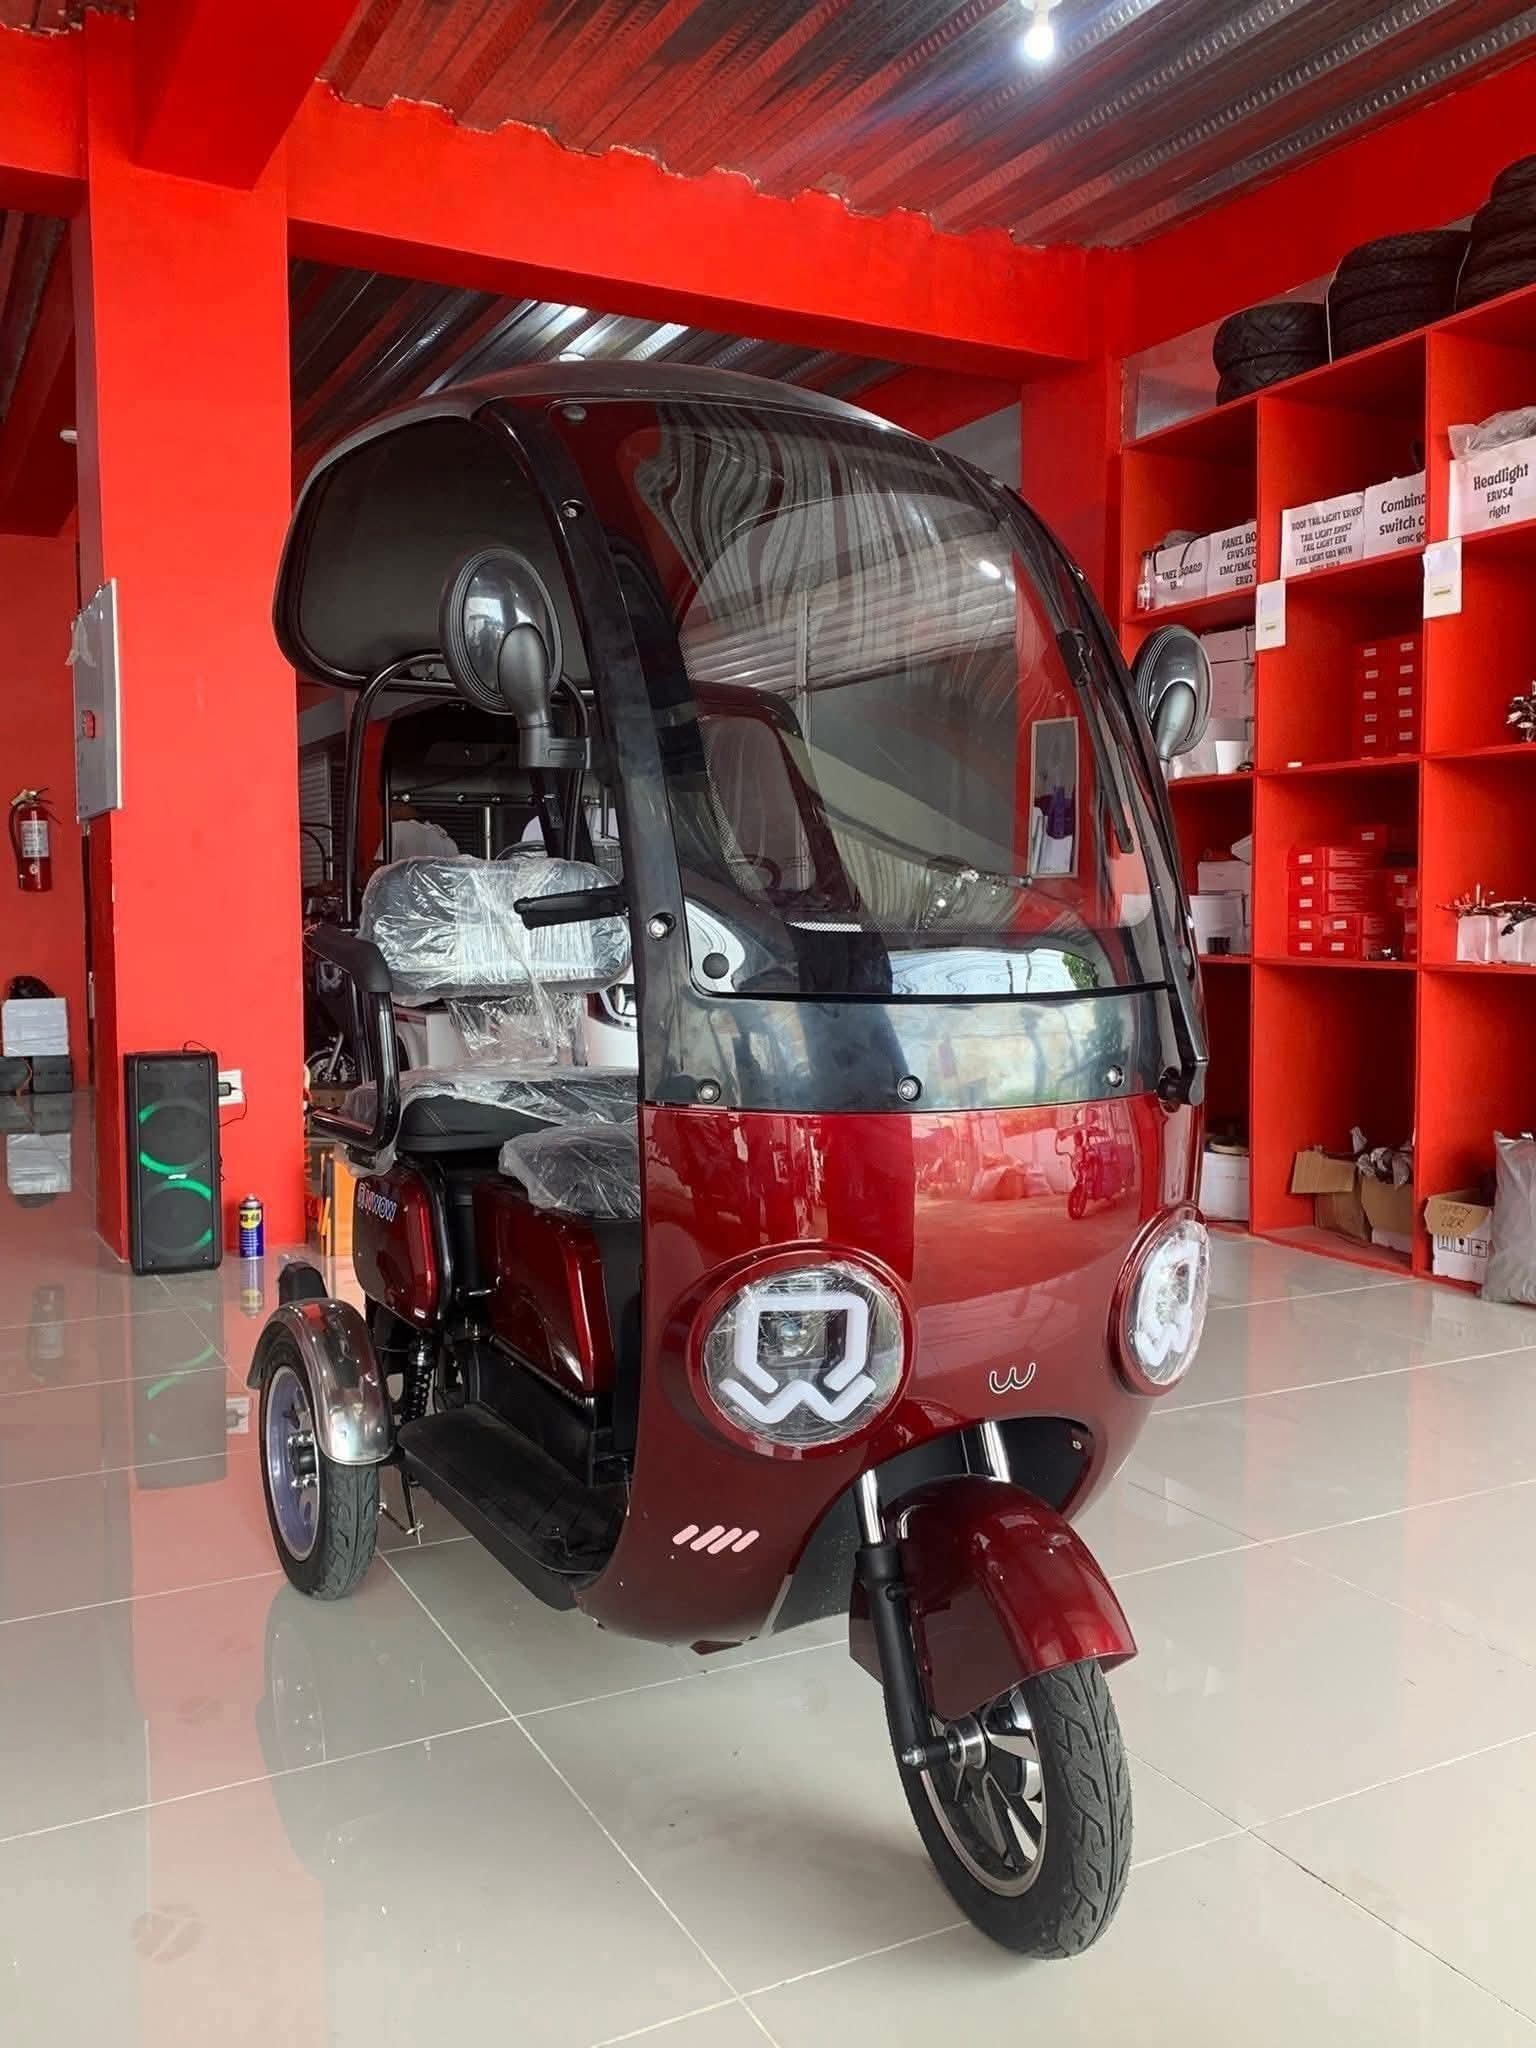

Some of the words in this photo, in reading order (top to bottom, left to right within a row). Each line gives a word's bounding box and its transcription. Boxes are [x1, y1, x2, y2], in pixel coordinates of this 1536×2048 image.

[1473, 463, 1529, 490] Headlight
[1486, 486, 1513, 503] ERVS4
[1308, 516, 1321, 528] TAIL
[1321, 511, 1342, 524] LIGHT
[1488, 504, 1511, 519] right
[1379, 515, 1416, 536] switch
[1221, 535, 1244, 551] PANEL
[1300, 532, 1314, 544] TAIL
[1314, 527, 1333, 540] LIGHT
[1397, 533, 1415, 545] emc
[1303, 543, 1315, 553] TAIL
[1315, 537, 1334, 550] LIGHT
[1295, 557, 1309, 567] TAIL
[1309, 552, 1325, 563] LIGHT
